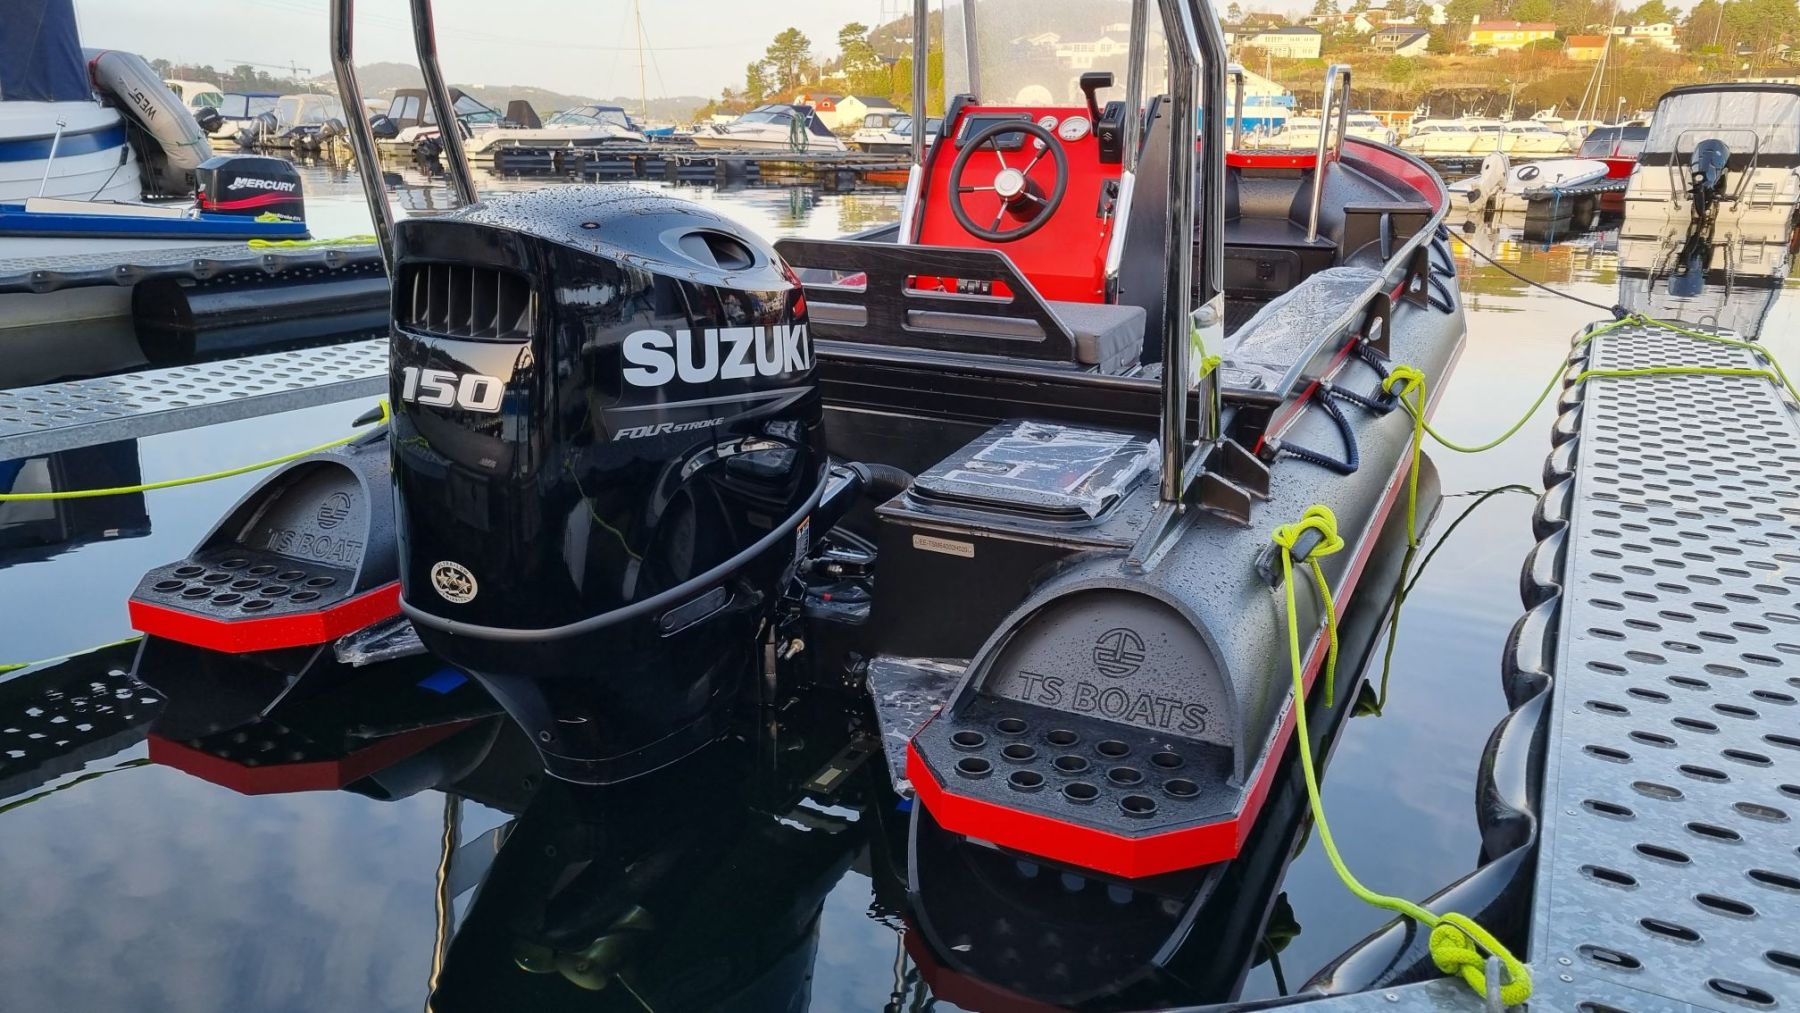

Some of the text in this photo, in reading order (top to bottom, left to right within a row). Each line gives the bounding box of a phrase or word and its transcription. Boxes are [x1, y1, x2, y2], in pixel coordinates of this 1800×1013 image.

[227, 176, 296, 192] MERCURY
[622, 324, 811, 387] SUZUKI
[402, 366, 506, 414] 150
[300, 532, 364, 564] BOAT
[1018, 670, 1209, 736] TS BOATS
